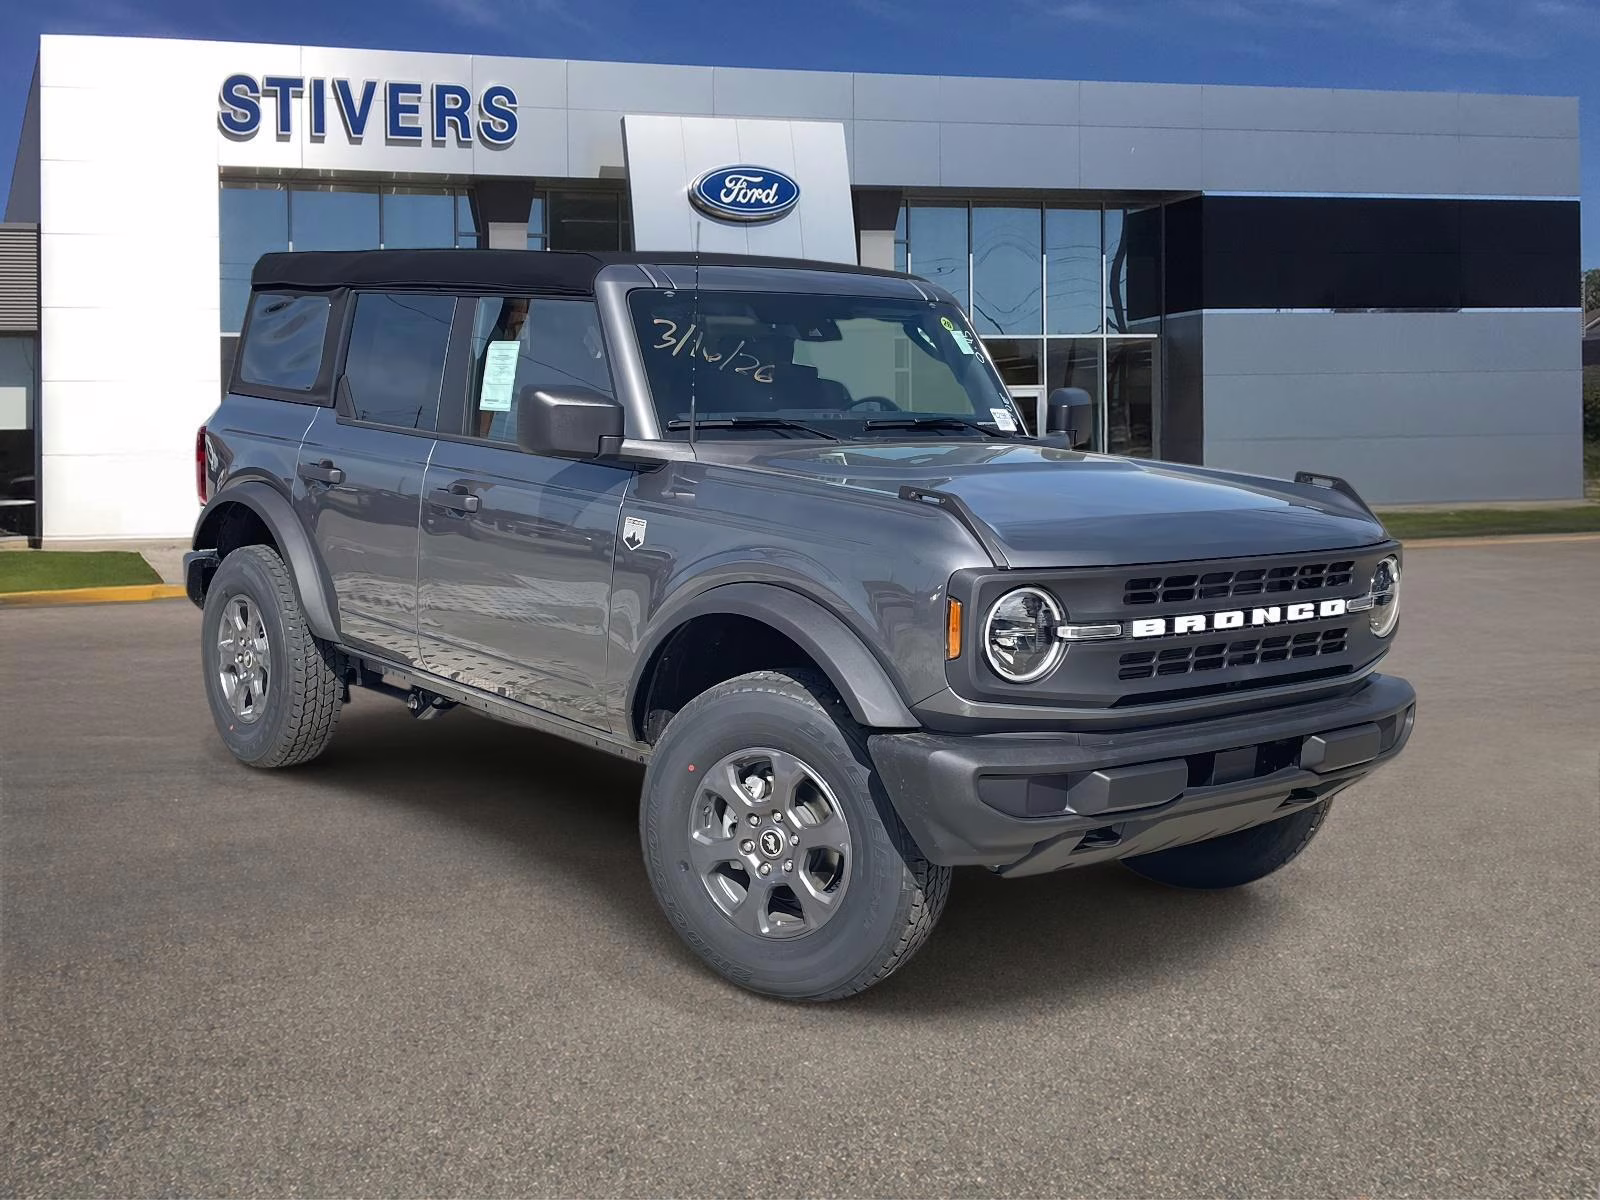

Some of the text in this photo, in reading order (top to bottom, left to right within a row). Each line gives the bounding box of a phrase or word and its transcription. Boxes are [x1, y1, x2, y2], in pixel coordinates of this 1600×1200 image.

[218, 73, 518, 145] STIVERS
[720, 174, 779, 204] Ford
[1132, 599, 1346, 638] BRONCO
